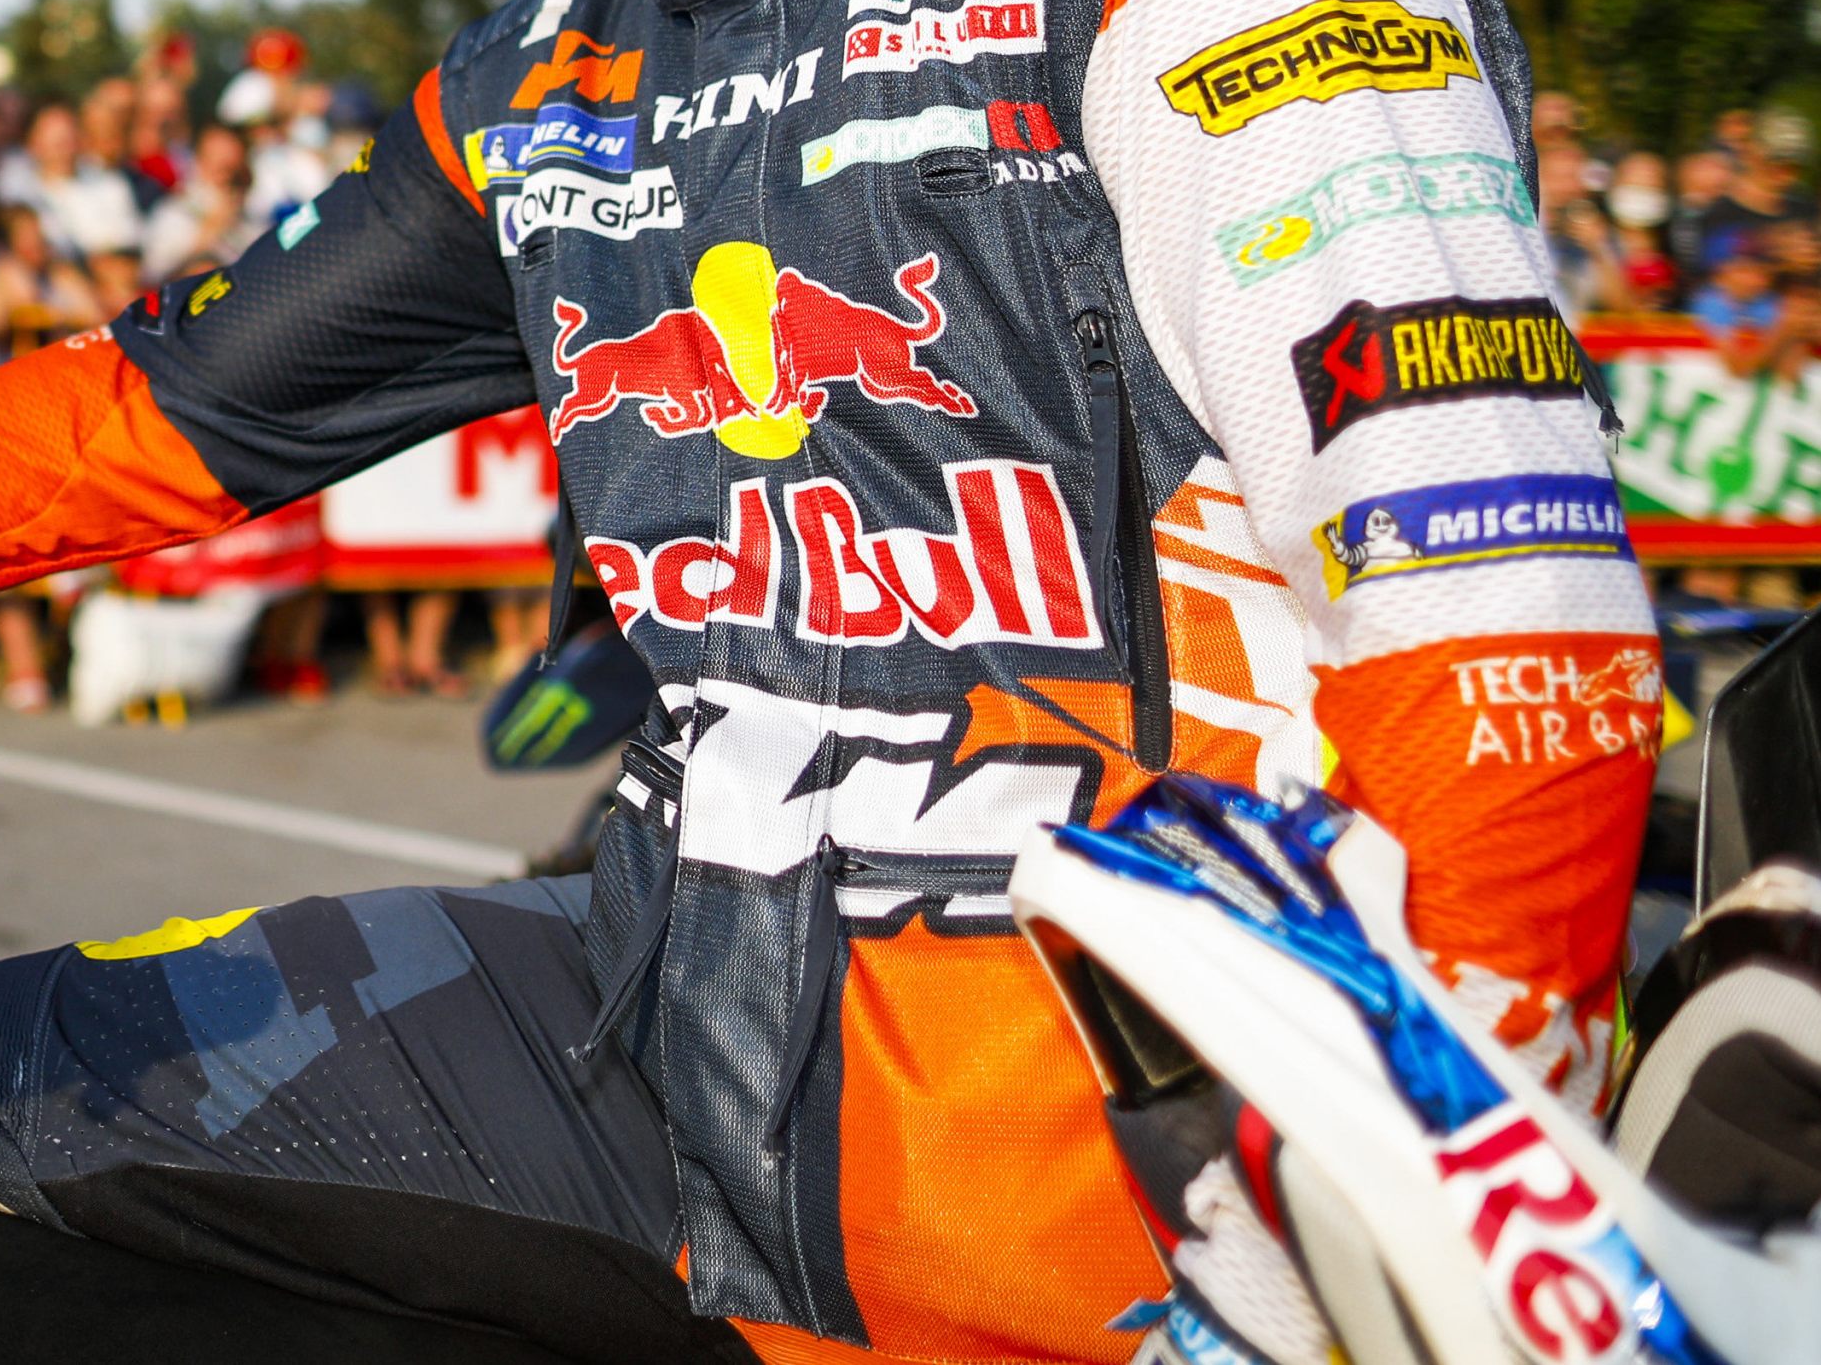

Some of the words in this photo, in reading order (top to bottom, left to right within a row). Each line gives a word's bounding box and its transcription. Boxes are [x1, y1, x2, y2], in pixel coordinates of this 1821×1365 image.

[652, 46, 825, 144] KINI
[1171, 10, 1470, 118] TECHNOGYM
[583, 477, 780, 637] ed
[783, 459, 1105, 650] Bull
[1449, 654, 1580, 707] TECH
